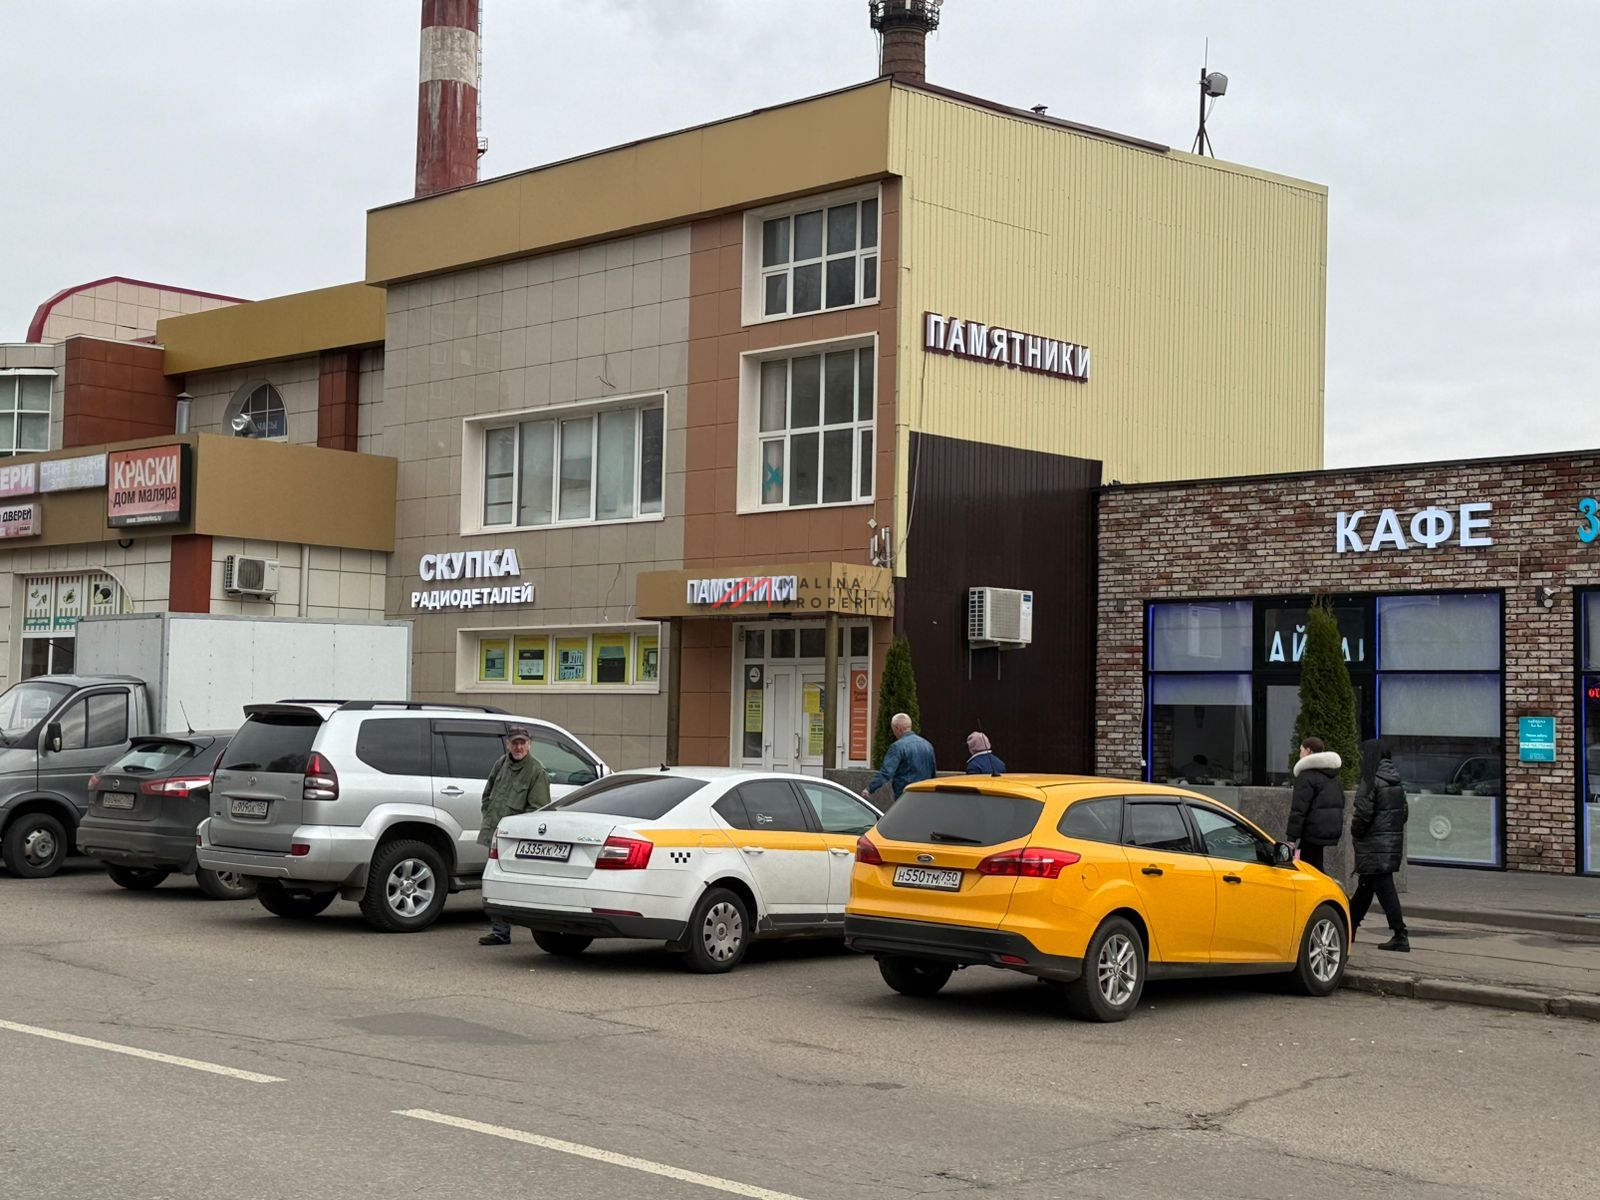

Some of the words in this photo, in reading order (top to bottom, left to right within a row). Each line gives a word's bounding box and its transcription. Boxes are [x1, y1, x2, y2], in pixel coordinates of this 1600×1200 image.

[923, 313, 1091, 381] ПАМЯТНИКИ
[114, 455, 177, 489] КРАСКИ
[113, 490, 135, 508] дом
[138, 486, 177, 504] маляра
[2, 508, 32, 522] ДВЕРЕЙ
[1336, 502, 1494, 553] КАФЕ
[419, 548, 521, 581] СКУПКА
[411, 582, 535, 610] РАДИОДЕТАЛЕЙ
[687, 576, 798, 604] ПАМЯТНИКИ
[519, 843, 552, 856] А335КК
[553, 843, 568, 855] 797
[898, 869, 939, 884] Н550ТМ
[940, 871, 958, 882] 750
